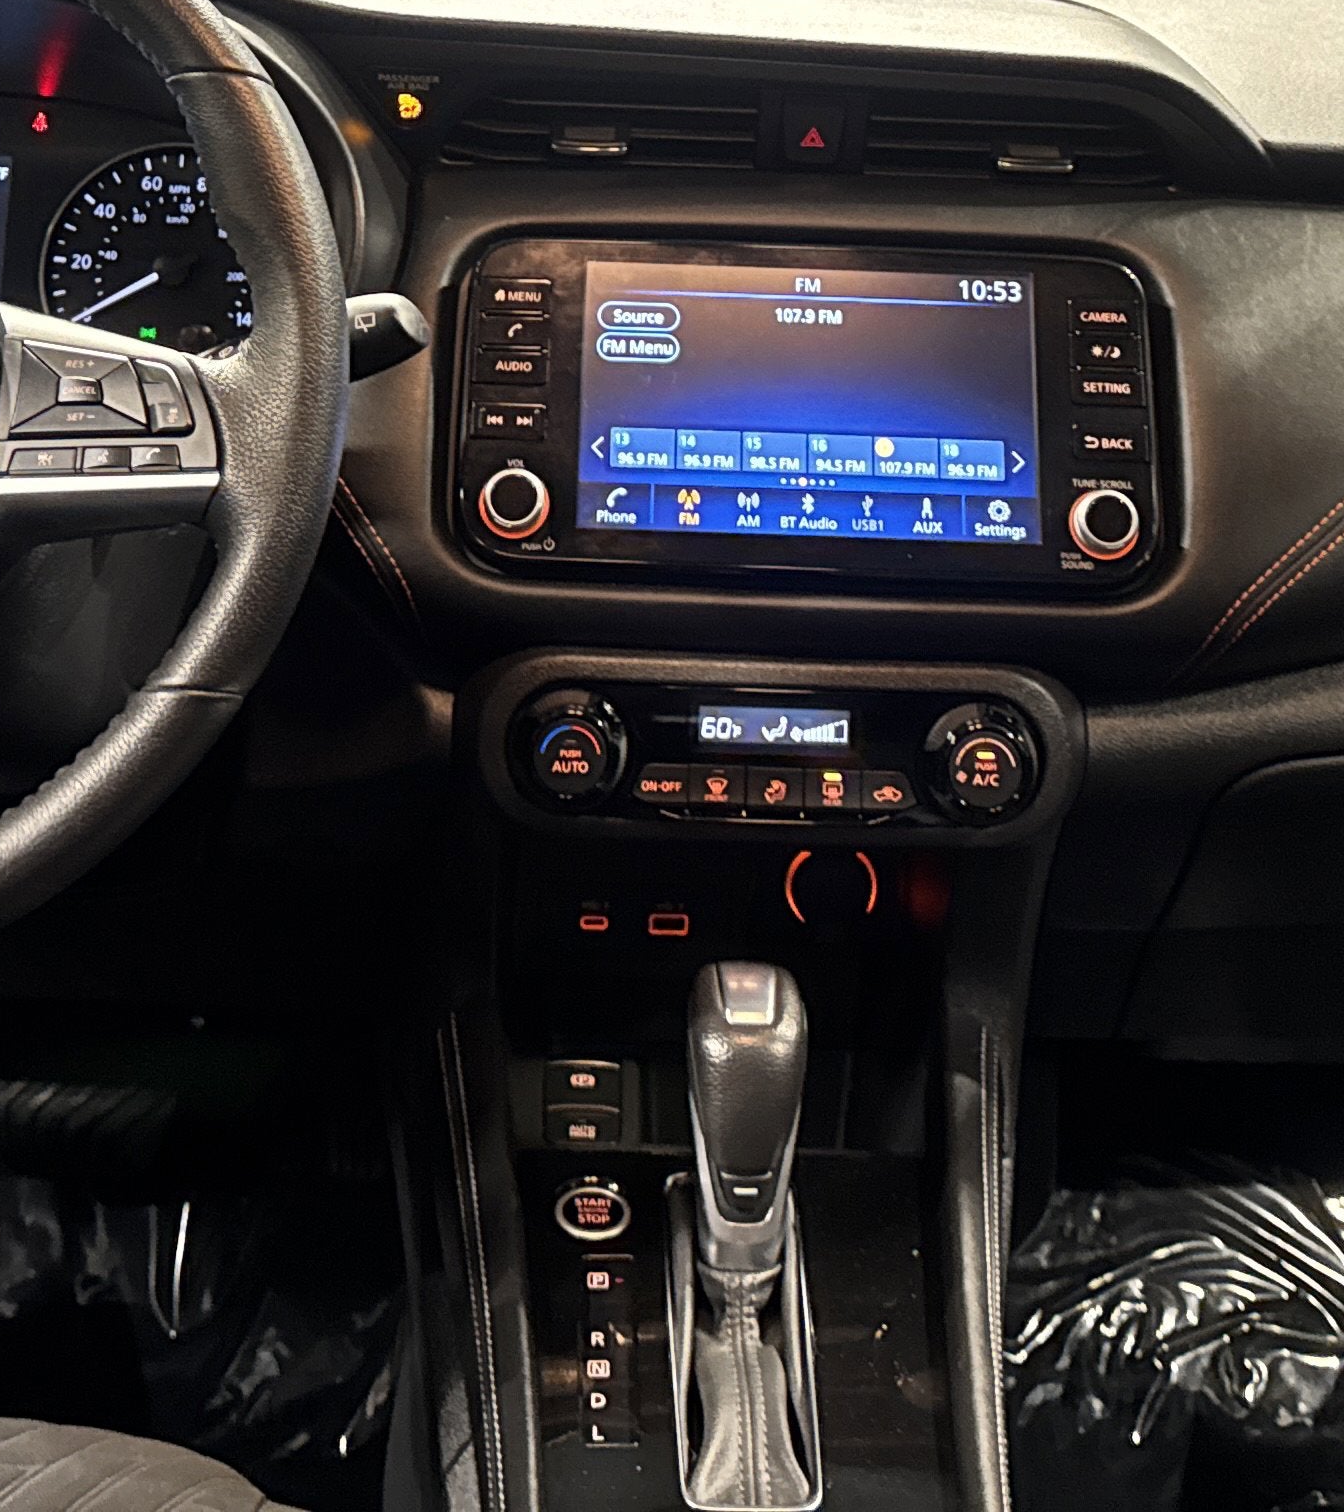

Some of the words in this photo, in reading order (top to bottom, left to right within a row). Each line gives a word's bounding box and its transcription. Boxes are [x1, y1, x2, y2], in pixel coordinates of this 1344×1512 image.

[141, 175, 163, 192] 60
[93, 203, 116, 219] 40
[71, 253, 92, 270] 20
[104, 250, 118, 261] 40
[795, 277, 821, 293] FM
[959, 279, 1022, 302] 10:53
[508, 291, 541, 302] MENU
[613, 308, 664, 325] Source
[774, 307, 815, 324] 107.9
[818, 309, 843, 325] FM
[1080, 311, 1127, 324] CAMERA
[602, 338, 626, 354] FM
[629, 339, 674, 355] Menu
[495, 360, 533, 372] AUDIO
[1082, 381, 1131, 394] SETTING
[1101, 438, 1134, 450] BACK
[507, 459, 525, 468] VOL
[647, 453, 668, 466] FM
[713, 455, 734, 469] FM
[779, 457, 800, 471] FM
[845, 459, 866, 473] FM
[915, 462, 936, 476] FM
[977, 464, 998, 478] FM
[596, 509, 637, 525] Phone
[678, 512, 700, 525] FM
[736, 514, 761, 527] AM
[779, 516, 798, 529] BT
[798, 516, 838, 531] Audio
[851, 518, 884, 532] USB1
[912, 521, 944, 534] AUX
[974, 522, 1027, 541] Settings
[552, 760, 589, 774] AUTO
[972, 773, 1000, 787] A/C
[577, 1213, 611, 1224] STOP
[590, 1331, 606, 1348] R
[590, 1392, 607, 1409] D
[591, 1424, 605, 1441] L
